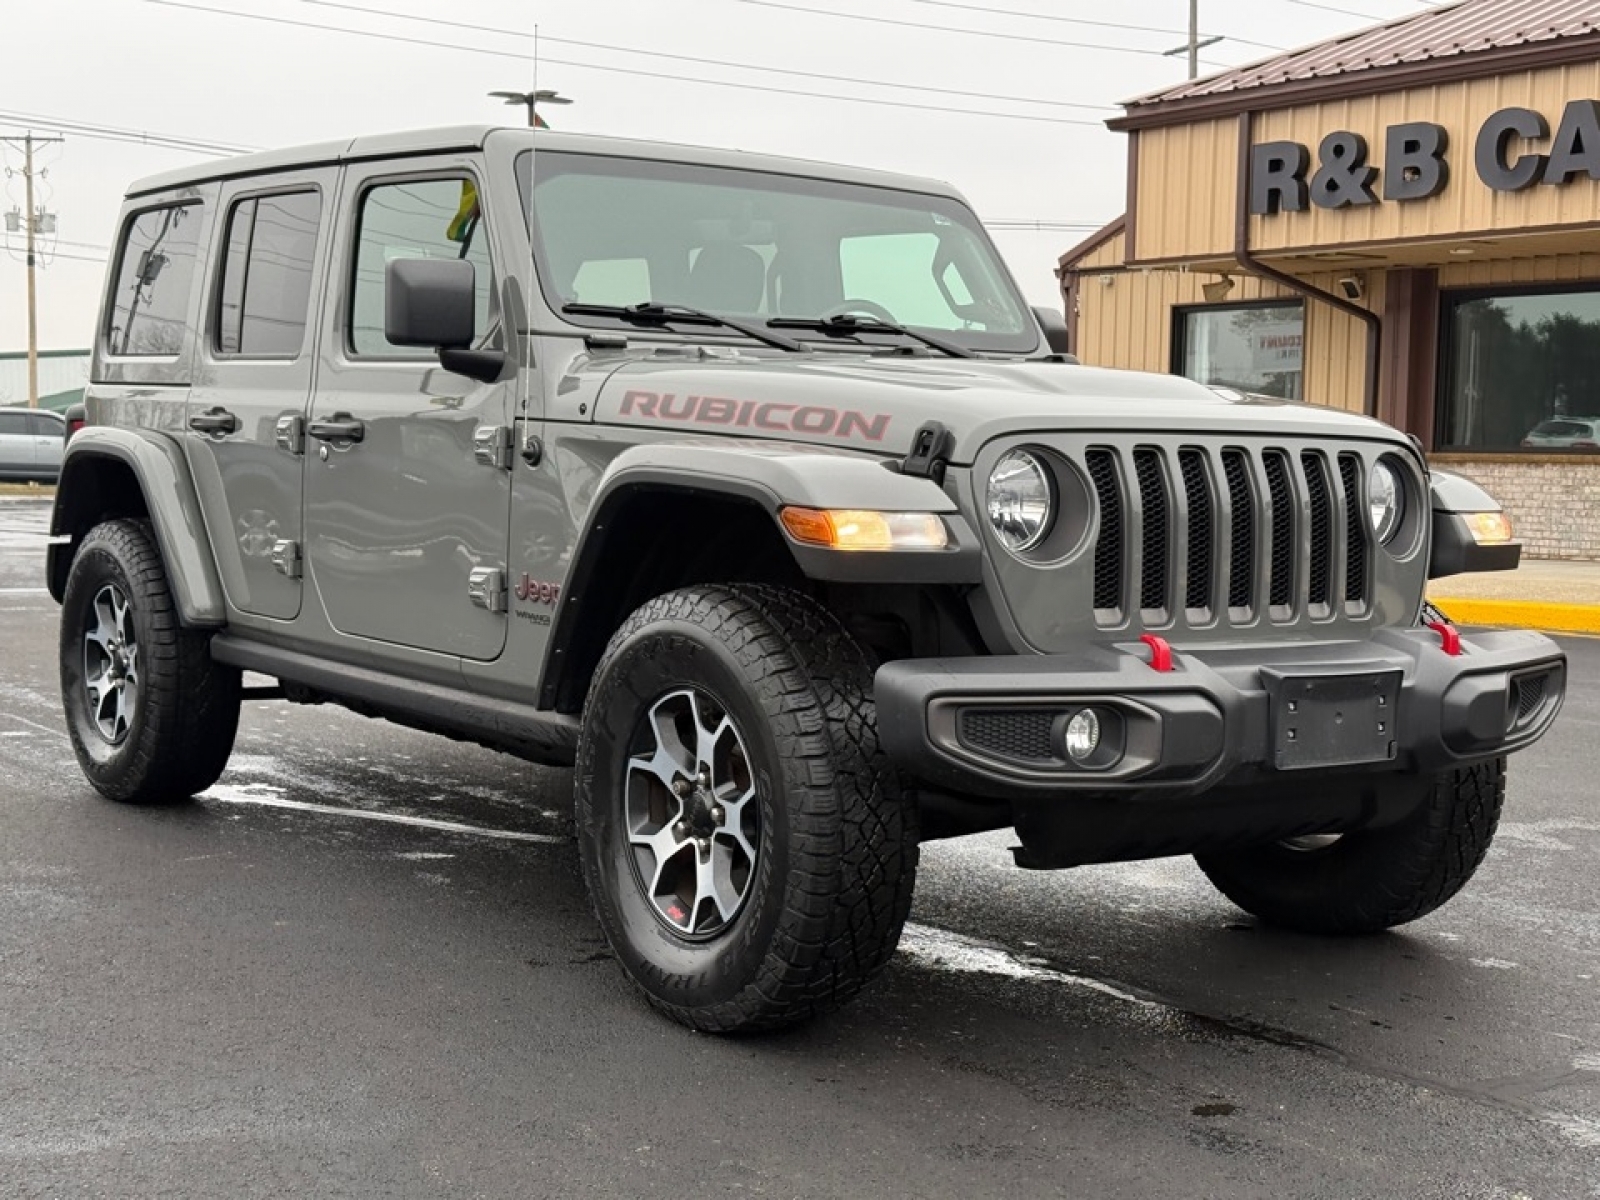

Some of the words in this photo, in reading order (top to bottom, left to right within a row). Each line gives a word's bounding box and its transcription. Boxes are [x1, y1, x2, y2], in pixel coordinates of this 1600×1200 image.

[1250, 121, 1449, 215] R&B
[1475, 99, 1600, 192] CA
[619, 389, 893, 442] RUBICON
